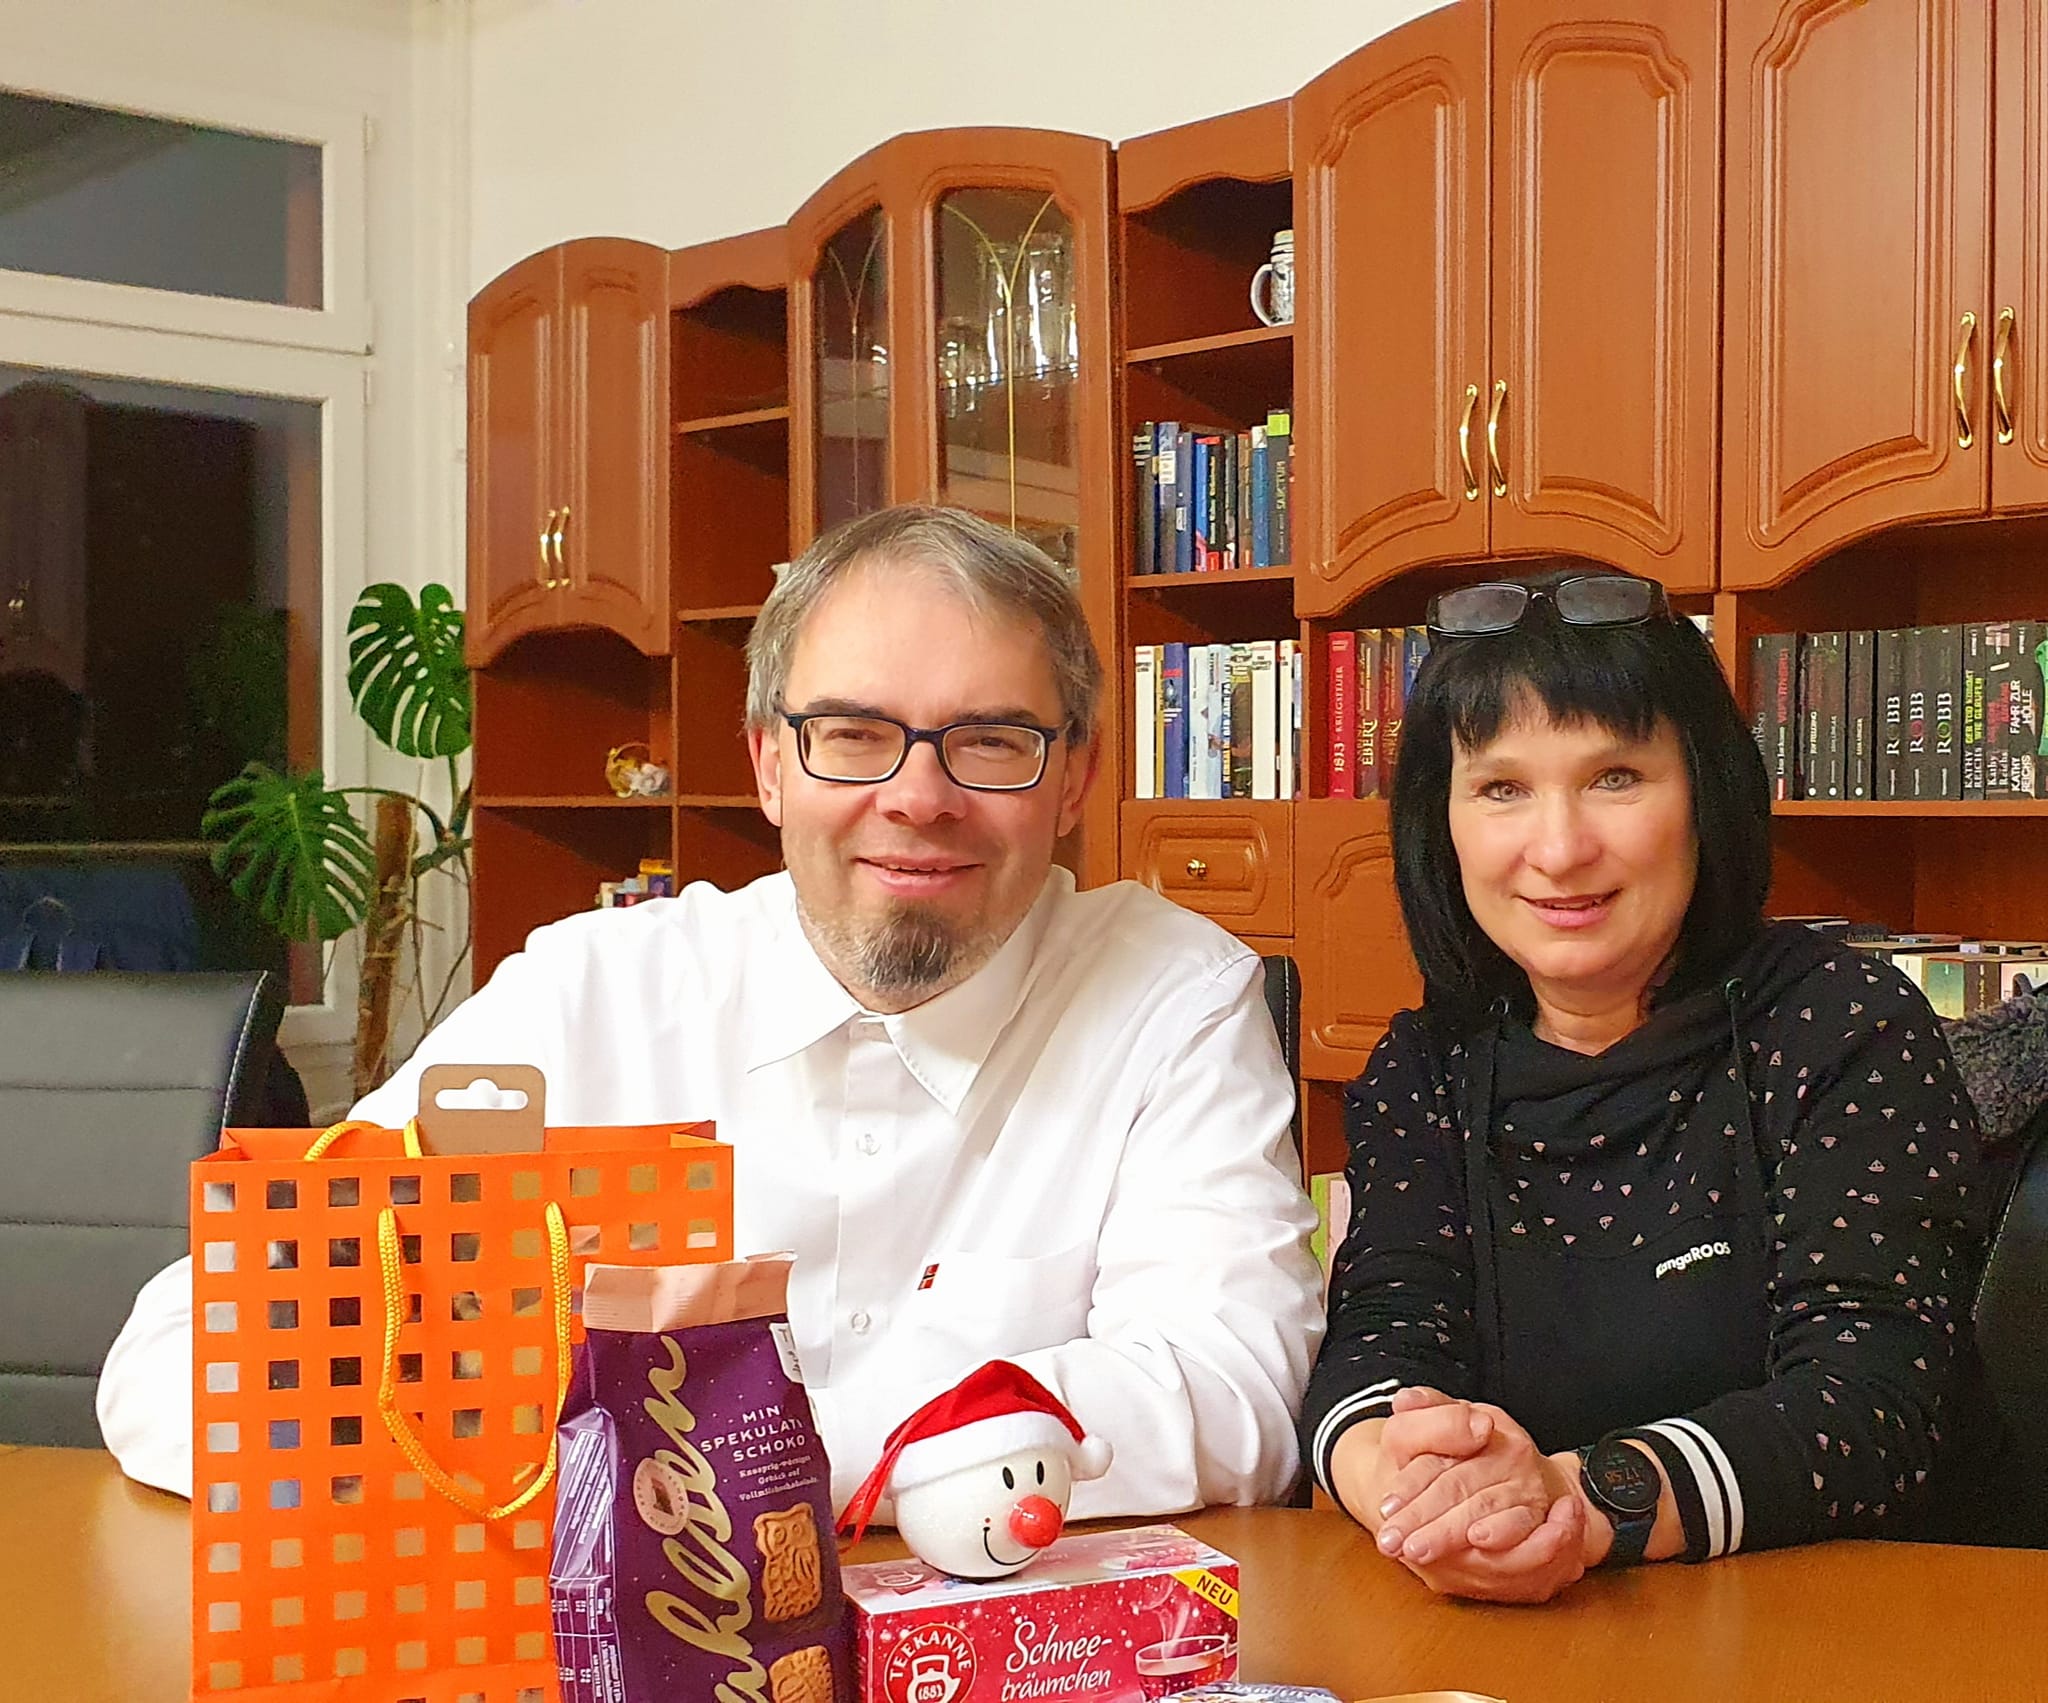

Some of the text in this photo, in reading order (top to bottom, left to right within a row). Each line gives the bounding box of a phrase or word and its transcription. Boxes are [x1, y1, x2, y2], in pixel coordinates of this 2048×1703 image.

[1335, 666, 1344, 733] KRIEGSFEUER
[2010, 680, 2020, 734] FAHR ZUR
[2020, 689, 2032, 724] HÖLLE
[1362, 718, 1378, 765] EBERT
[1886, 696, 1901, 755] ROBB
[1909, 692, 1924, 753] ROBB
[1936, 692, 1952, 754] ROBB
[1333, 742, 1345, 772] 1813
[1965, 750, 1973, 788] KATHY
[1987, 755, 1998, 786] Kathy
[1998, 752, 2008, 785] Reichs
[2012, 757, 2020, 791] KATHY
[2021, 754, 2030, 792] REICHS
[733, 1435, 806, 1462] SCHOKO
[1196, 1573, 1234, 1606] NEU
[889, 1630, 972, 1682] TEEKANNE
[1005, 1620, 1113, 1674] Schnee-
[1001, 1658, 1112, 1703] träumchen
